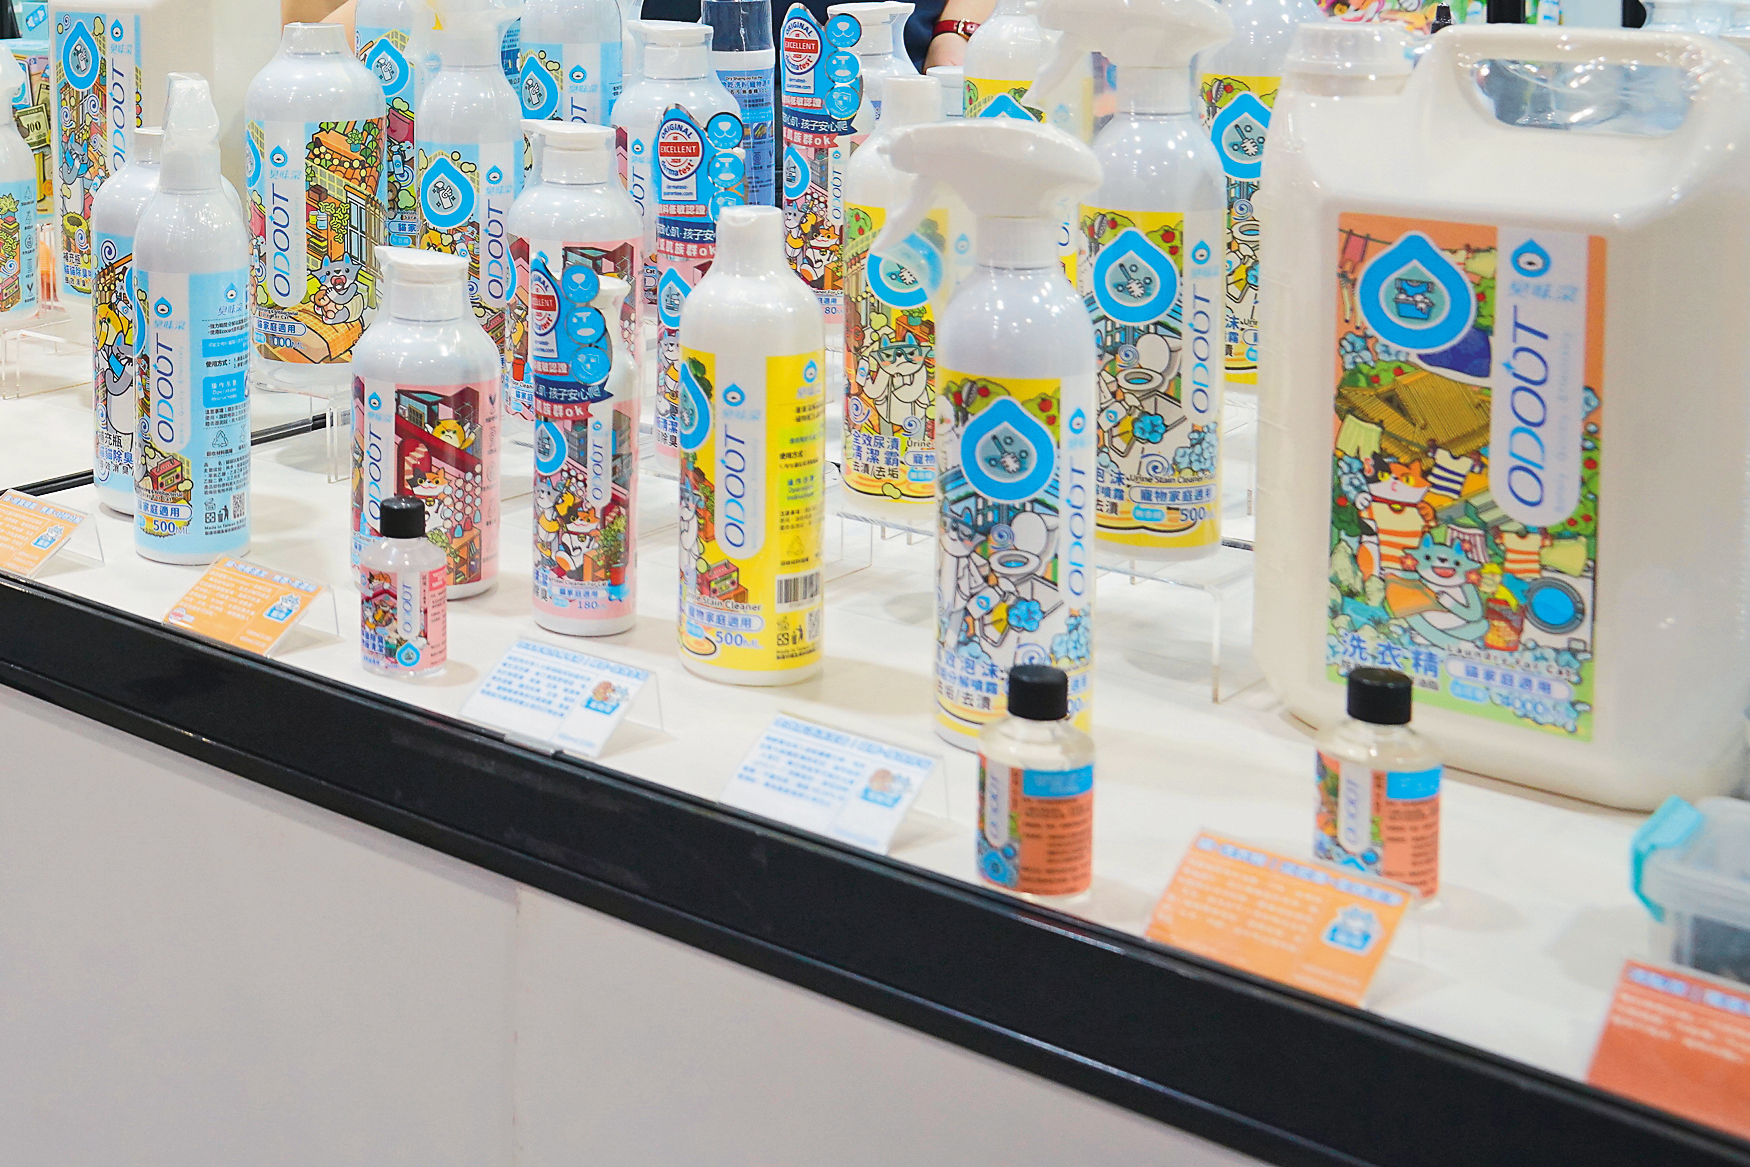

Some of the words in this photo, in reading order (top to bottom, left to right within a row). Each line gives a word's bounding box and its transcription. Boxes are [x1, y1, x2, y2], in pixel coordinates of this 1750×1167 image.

[784, 41, 816, 51] EXCELLENT
[785, 21, 814, 37] ORIGINAL
[111, 58, 126, 173] ODOUT
[660, 122, 693, 140] ORIGINAL
[659, 144, 697, 155] EXCELLENT
[831, 169, 843, 220] ODOUT
[271, 183, 291, 298] ODOUT
[487, 198, 506, 302] ODOUT
[1188, 283, 1212, 415] ODOUT
[154, 331, 175, 445] ODOUT
[1506, 304, 1550, 508] ODOUT
[852, 429, 900, 451] 全效尿漬
[906, 439, 932, 448] Urine
[368, 423, 383, 522] ODOUT
[591, 439, 604, 501] ODOUT
[723, 424, 746, 549] ODOUT
[1128, 473, 1153, 484] Urine
[1154, 475, 1175, 484] Stain
[1176, 473, 1204, 484] Cleaner
[152, 519, 191, 535] 500ML
[1068, 457, 1086, 597] ODOUT
[702, 593, 723, 607] Stain
[724, 600, 762, 612] Cleaner
[1342, 631, 1440, 679] 洗衣精
